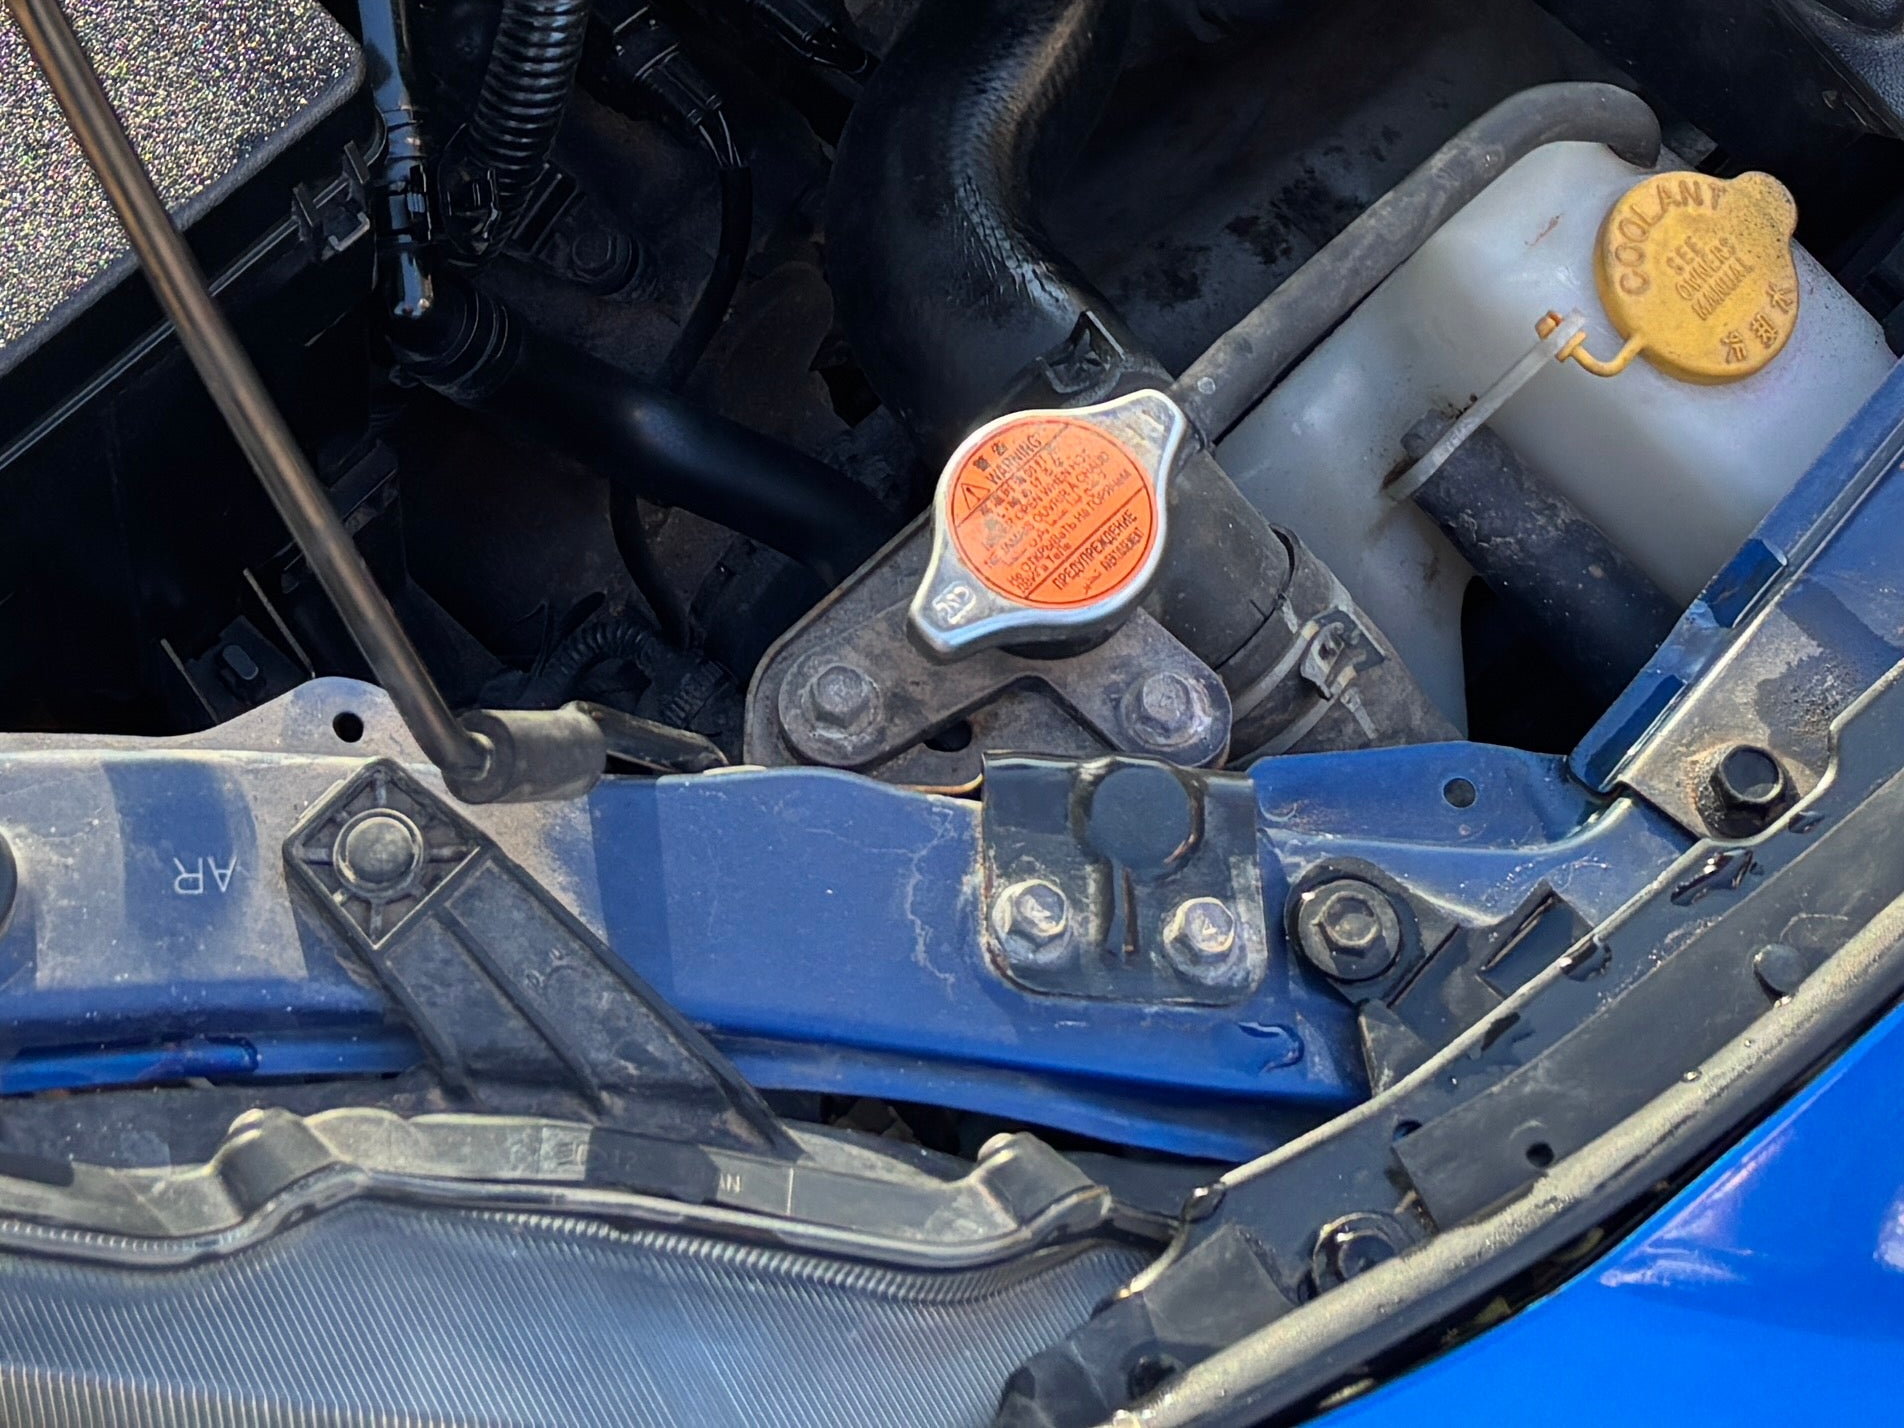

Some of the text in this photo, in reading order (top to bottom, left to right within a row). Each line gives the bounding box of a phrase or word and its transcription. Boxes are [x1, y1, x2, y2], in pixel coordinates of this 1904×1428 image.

[1614, 179, 1729, 297] COOLANT
[1665, 235, 1704, 275] SEE
[1691, 255, 1755, 322] MANUAL
[986, 432, 1043, 486] WARNING
[173, 856, 239, 896] AR
